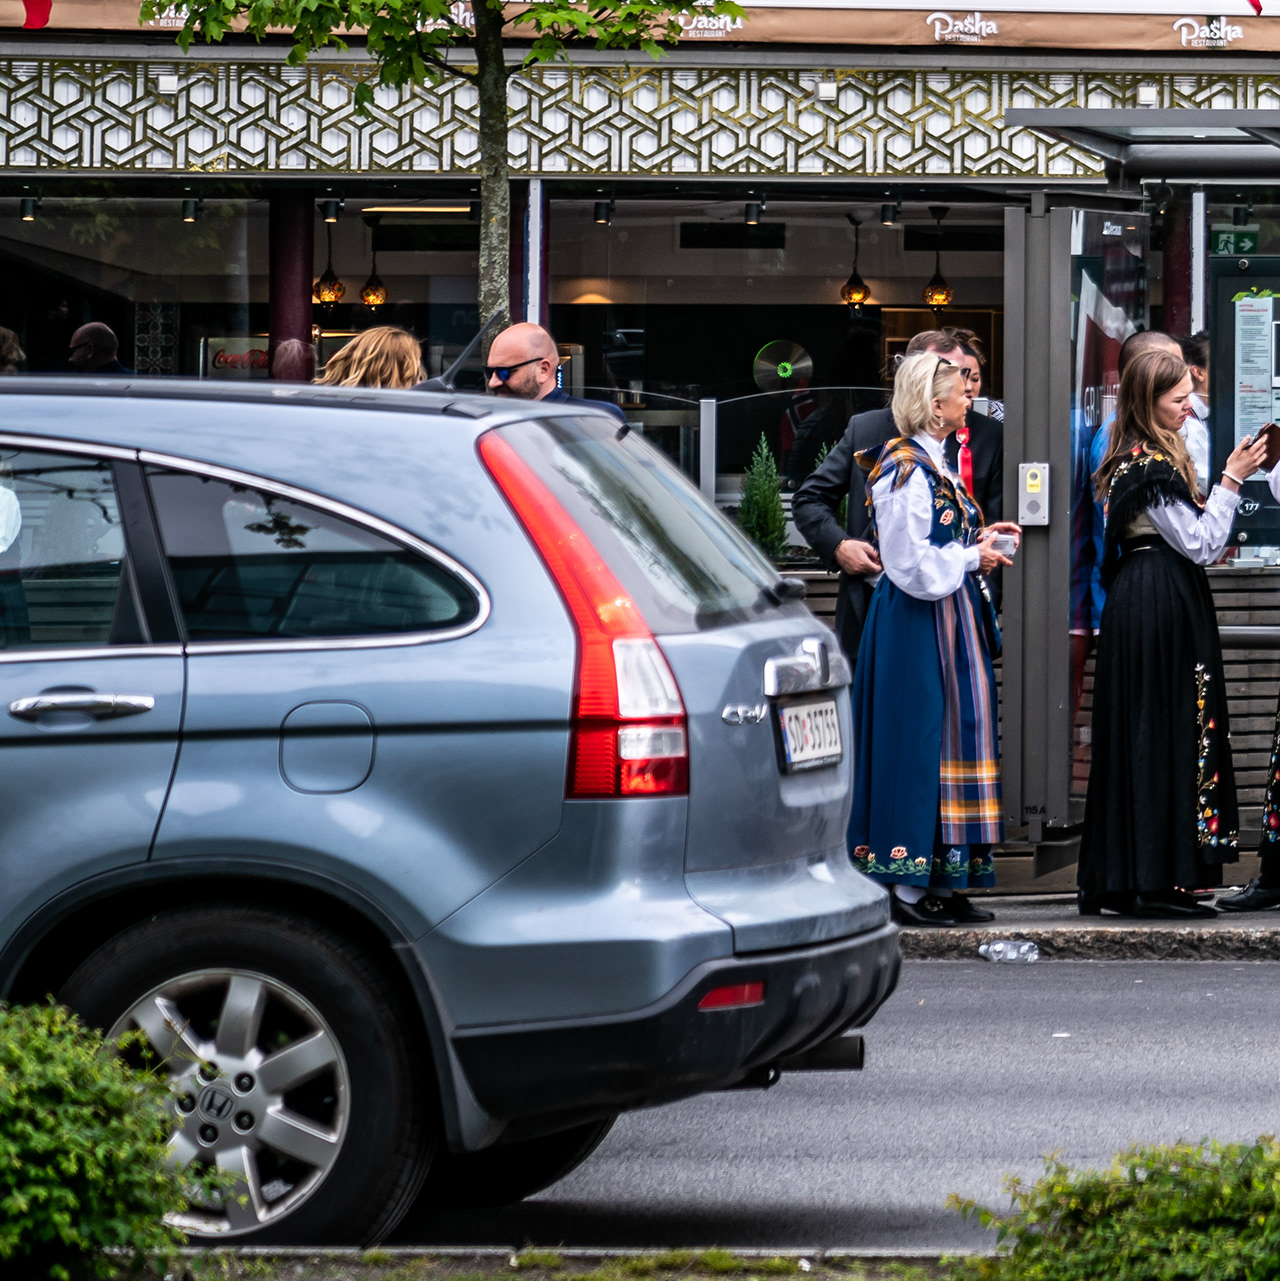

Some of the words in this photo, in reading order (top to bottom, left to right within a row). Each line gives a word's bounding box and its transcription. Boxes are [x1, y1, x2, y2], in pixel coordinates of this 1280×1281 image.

[926, 11, 999, 41] Pasha
[1172, 16, 1244, 47] Pasha
[1244, 503, 1259, 511] 177
